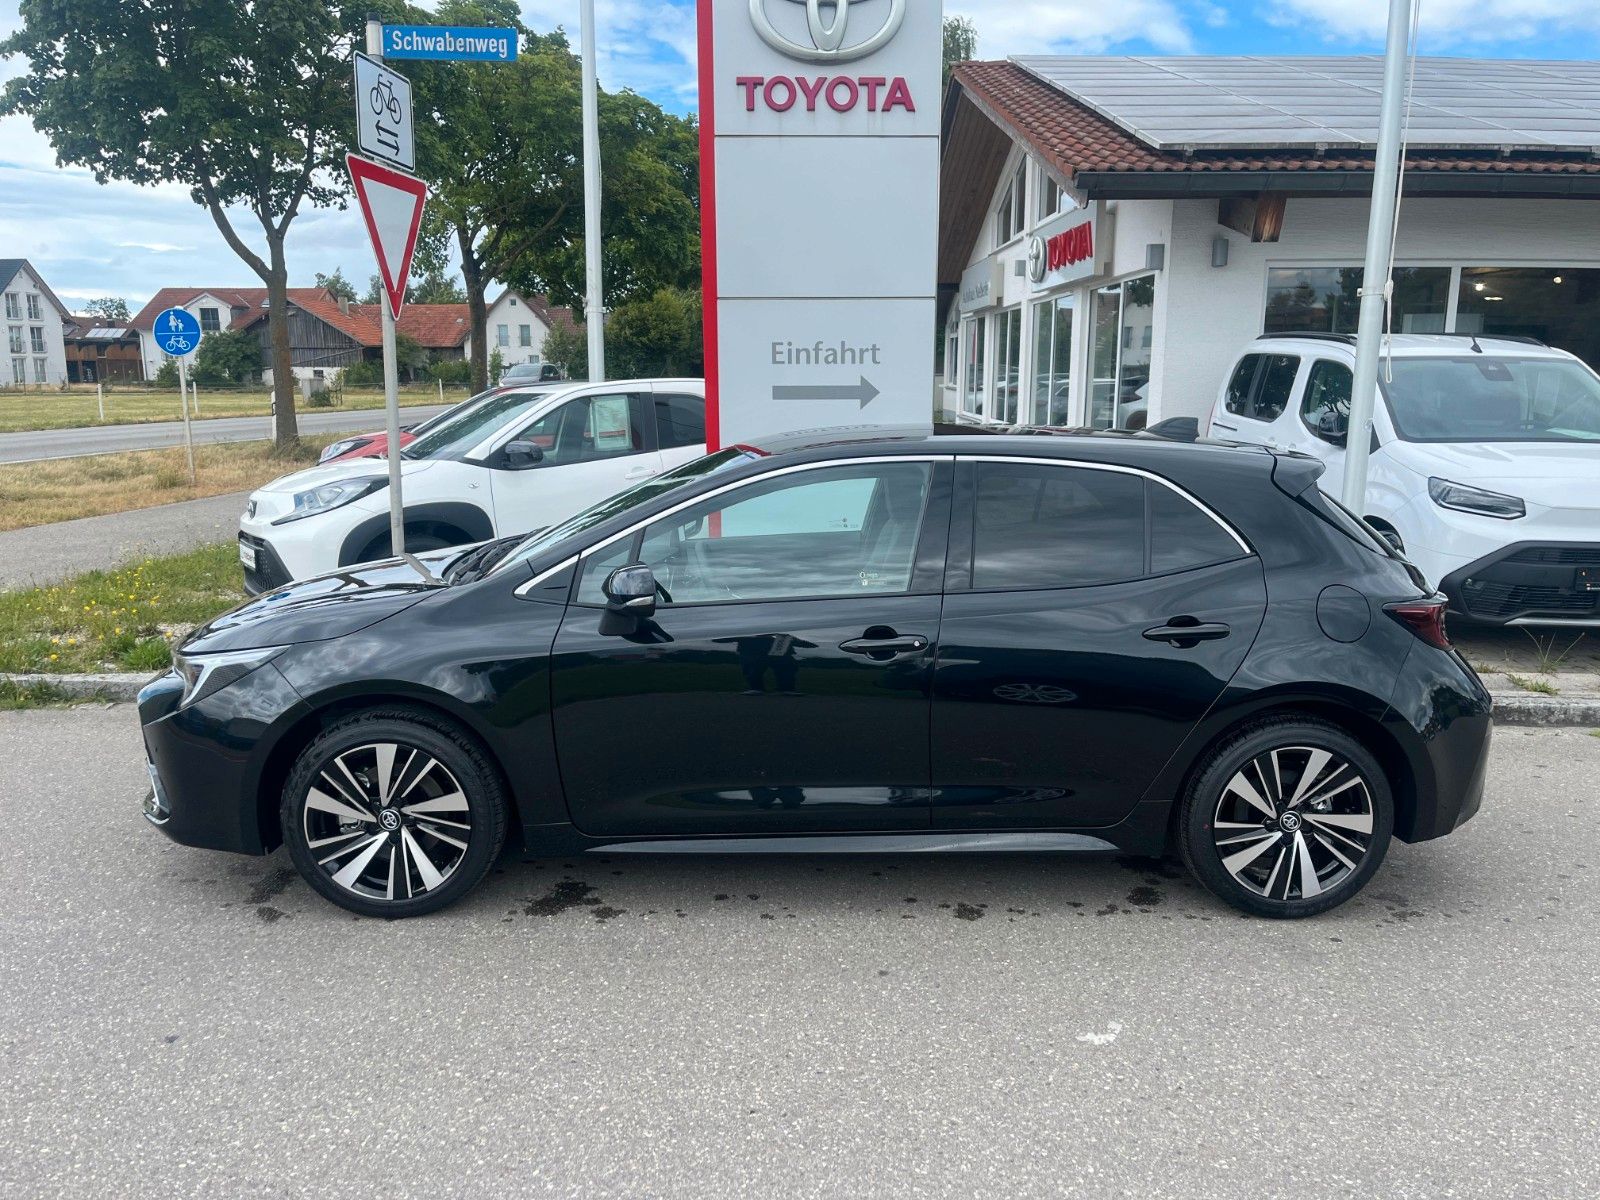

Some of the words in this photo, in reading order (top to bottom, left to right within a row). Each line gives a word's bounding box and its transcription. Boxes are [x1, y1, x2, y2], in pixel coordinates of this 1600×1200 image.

[392, 31, 508, 58] Schwabenweg
[736, 76, 916, 112] TOYOTA
[771, 340, 881, 365] Einfahrt
